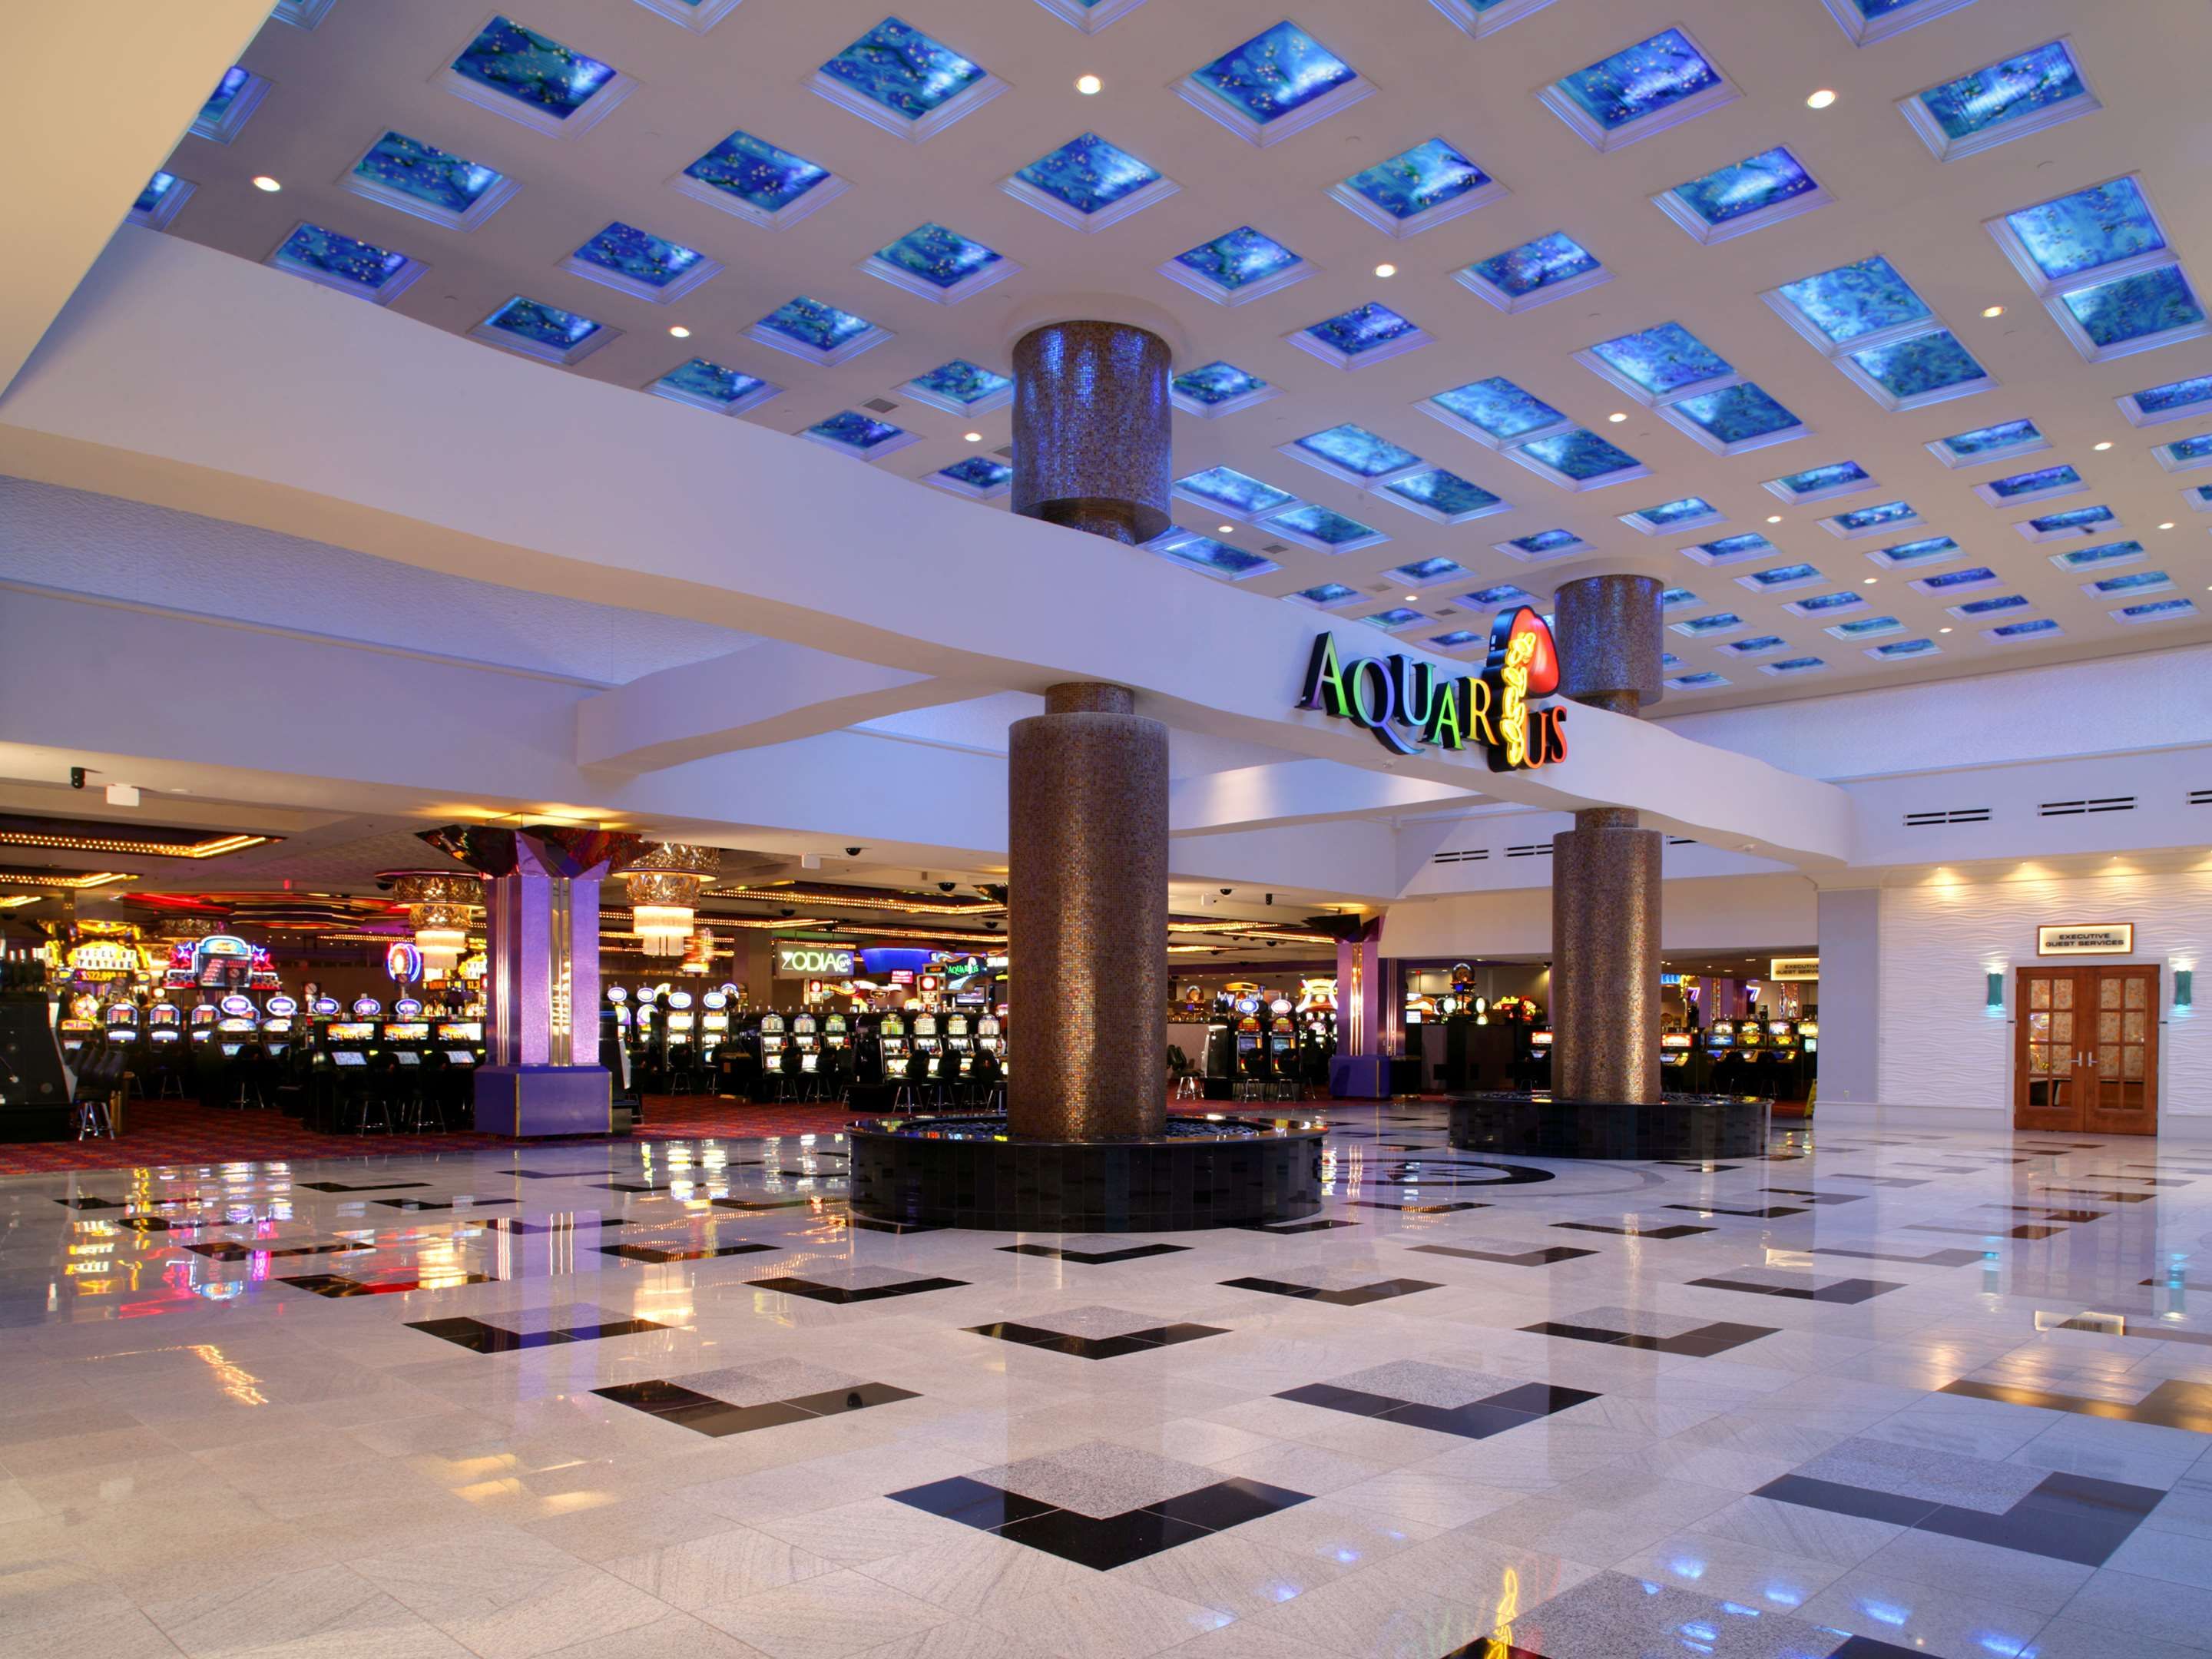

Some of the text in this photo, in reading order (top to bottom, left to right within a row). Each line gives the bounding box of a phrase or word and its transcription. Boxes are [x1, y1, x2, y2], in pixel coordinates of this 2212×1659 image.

[1294, 628, 1568, 771] AQUARIUS
[781, 951, 849, 972] ZODIAC
[839, 958, 852, 968] BAR
